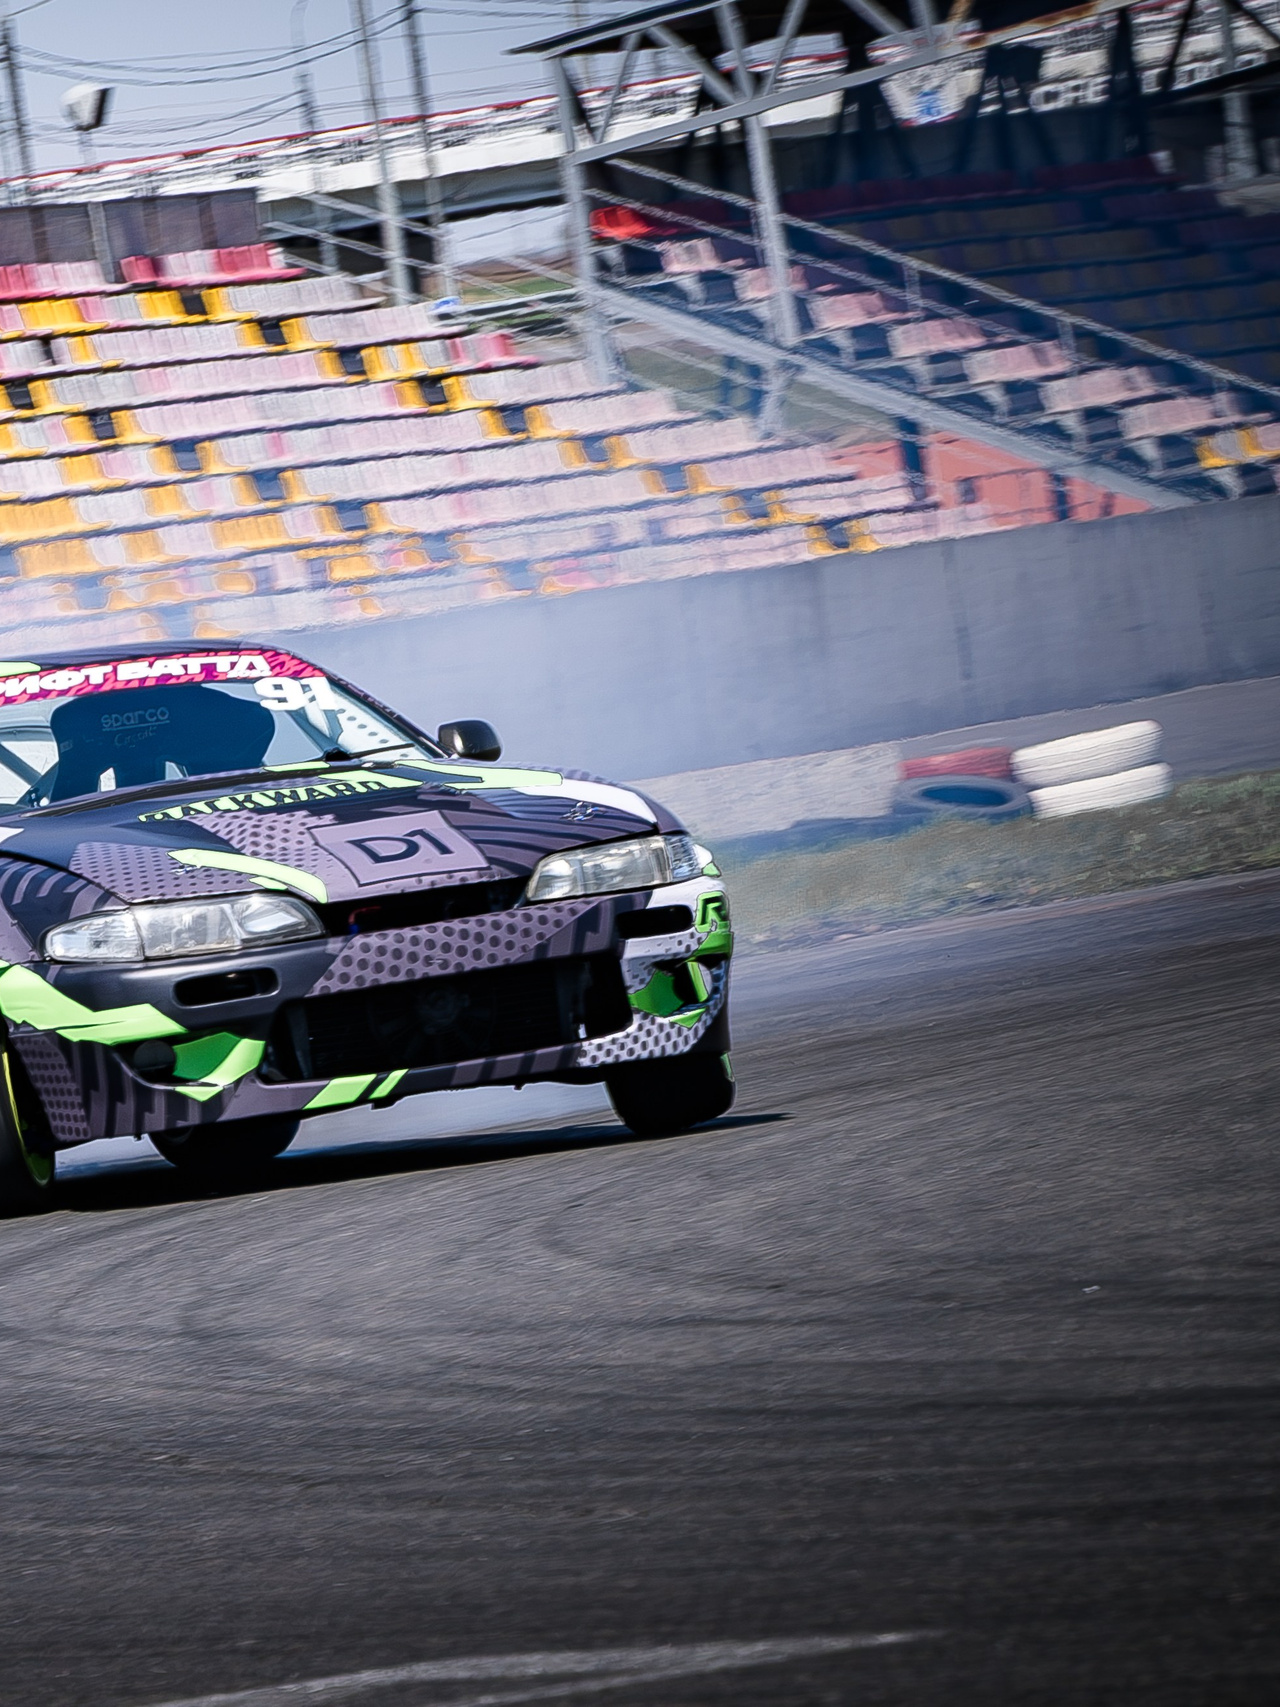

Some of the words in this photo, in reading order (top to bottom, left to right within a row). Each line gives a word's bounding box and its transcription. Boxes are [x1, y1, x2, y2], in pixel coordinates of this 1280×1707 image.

[253, 676, 337, 711] 91
[101, 706, 170, 728] sparco
[345, 828, 455, 864] D1
